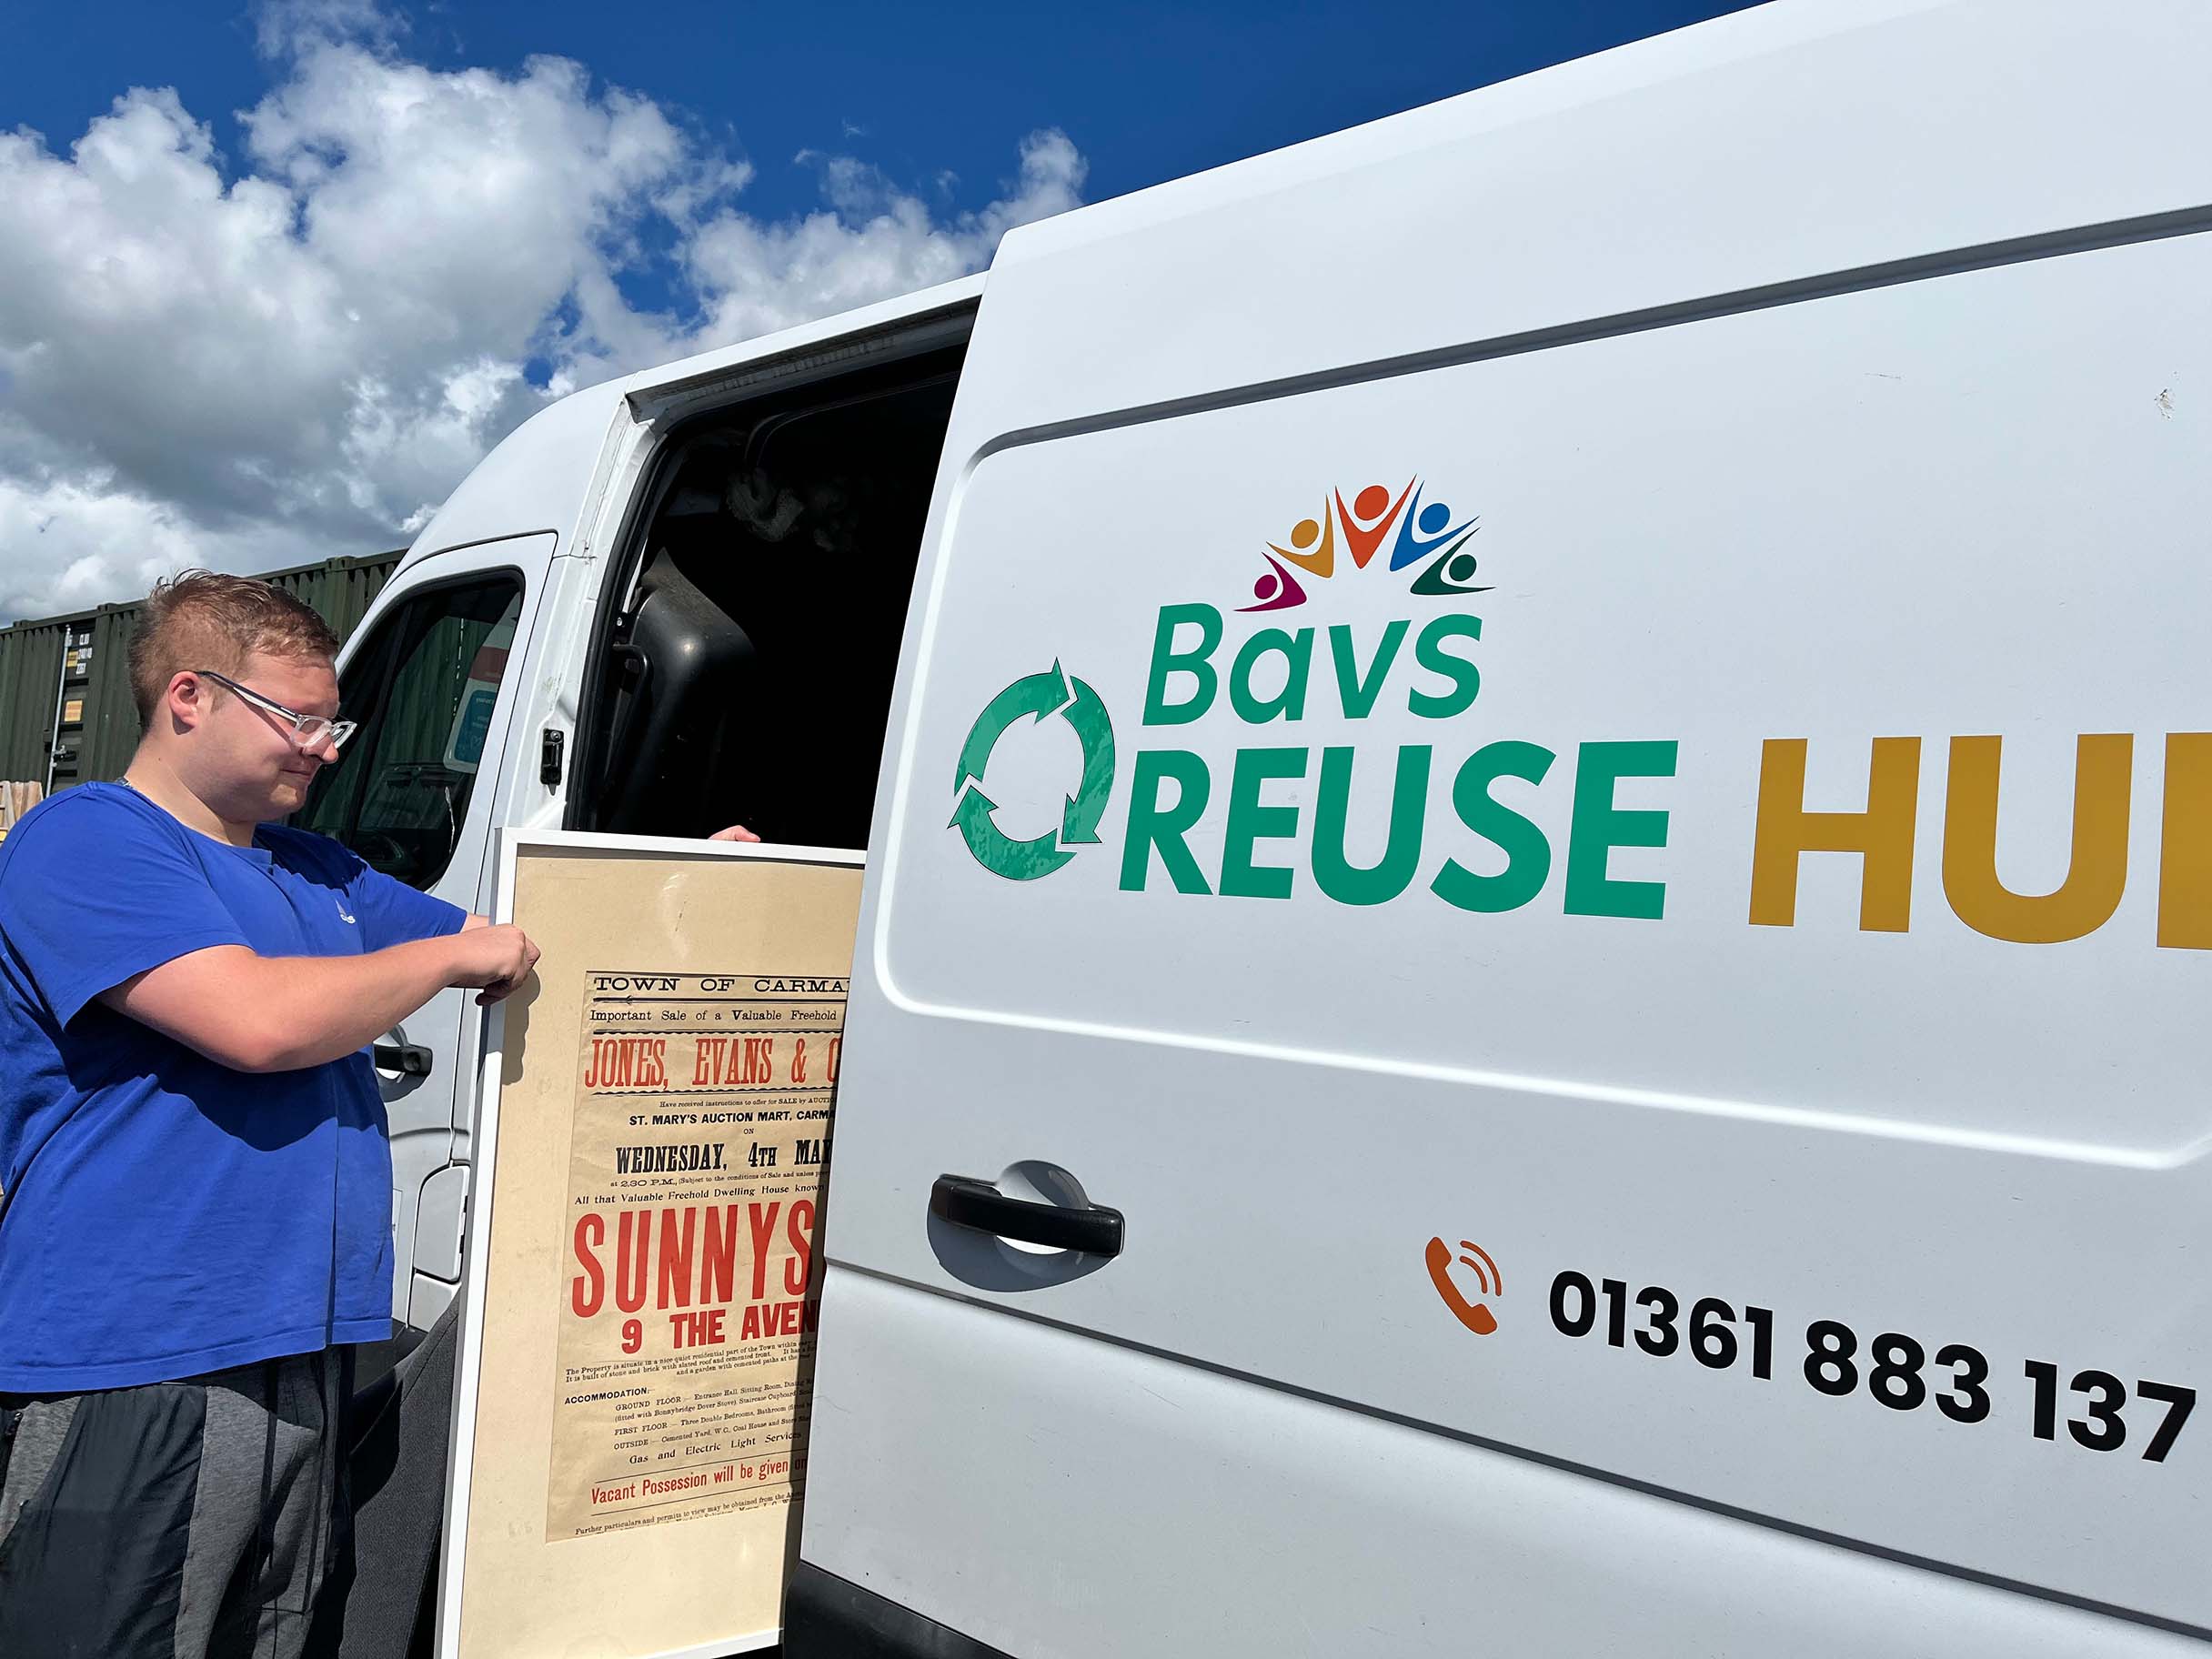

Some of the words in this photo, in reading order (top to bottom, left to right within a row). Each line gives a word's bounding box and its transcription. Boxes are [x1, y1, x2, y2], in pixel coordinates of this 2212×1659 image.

[1142, 602, 1483, 727] Bavs
[1119, 739, 1680, 920] REUSE
[593, 976, 680, 992] TOWN
[700, 978, 735, 991] OF
[754, 979, 850, 993] CARMA
[589, 1010, 651, 1024] Important
[661, 1010, 686, 1021] Sale
[696, 1010, 708, 1021] of
[714, 1012, 721, 1021] a
[731, 1010, 781, 1021] Valuable
[790, 1010, 837, 1021] Freehold
[585, 1039, 669, 1091] JONES,
[692, 1038, 773, 1086] EVANS
[791, 1038, 807, 1083] &
[629, 1115, 648, 1126] ST.
[652, 1113, 698, 1126] MARY'S
[701, 1112, 753, 1124] AUCTION
[616, 1143, 728, 1174] WEDNESDAY,
[749, 1142, 778, 1168] 4TH
[575, 1195, 589, 1205] All
[594, 1194, 616, 1204] that
[621, 1192, 663, 1203] Valuable
[669, 1190, 709, 1201] Freehold
[714, 1186, 755, 1199] Dwelling
[761, 1184, 789, 1194] House
[794, 1183, 825, 1192] known
[571, 1199, 816, 1319] SUNNYS
[621, 1319, 642, 1354] 9
[669, 1309, 726, 1349] THE
[740, 1300, 817, 1341] AVEN
[581, 1364, 612, 1375] Property
[674, 1354, 691, 1364] quiet
[692, 1351, 725, 1361] residential
[726, 1348, 739, 1357] part
[582, 1372, 599, 1380] built
[600, 1371, 608, 1379] of
[643, 1365, 660, 1373] brick
[679, 1361, 698, 1369] slated
[695, 1366, 717, 1375] garden
[733, 1360, 761, 1368] cemented
[762, 1358, 779, 1366] paths
[1548, 1270, 1775, 1381] 01361
[1803, 1319, 1992, 1424] 883
[2025, 1359, 2197, 1463] 137
[615, 1401, 651, 1412] GROUND
[656, 1396, 682, 1406] FLOOR
[694, 1392, 723, 1401] Entrance
[739, 1385, 762, 1393] Sitting
[615, 1414, 635, 1423] (fitted
[654, 1406, 696, 1417] Bonnybridge
[697, 1403, 716, 1411] Dover
[614, 1426, 638, 1436] FIRST
[641, 1422, 668, 1433] FLOOR
[680, 1418, 699, 1426] Three
[700, 1415, 723, 1424] Double
[757, 1406, 787, 1415] Bathroom
[613, 1439, 649, 1451] OUTSIDE
[661, 1433, 693, 1443] Cemented
[732, 1424, 747, 1433] Coal
[749, 1422, 768, 1430] House
[629, 1454, 649, 1464] Gas
[658, 1449, 676, 1461] and
[685, 1443, 721, 1455] Electric
[729, 1436, 756, 1451] Light
[591, 1483, 637, 1505] Vacant
[642, 1472, 709, 1496] Possession
[713, 1465, 734, 1484] will
[739, 1463, 753, 1480] be
[758, 1459, 789, 1481] given
[575, 1525, 602, 1535] Further
[603, 1519, 641, 1533] particulars
[642, 1515, 655, 1523] and
[657, 1513, 682, 1523] permits
[691, 1507, 706, 1515] view
[707, 1504, 721, 1513] may
[730, 1497, 759, 1509] obtained
